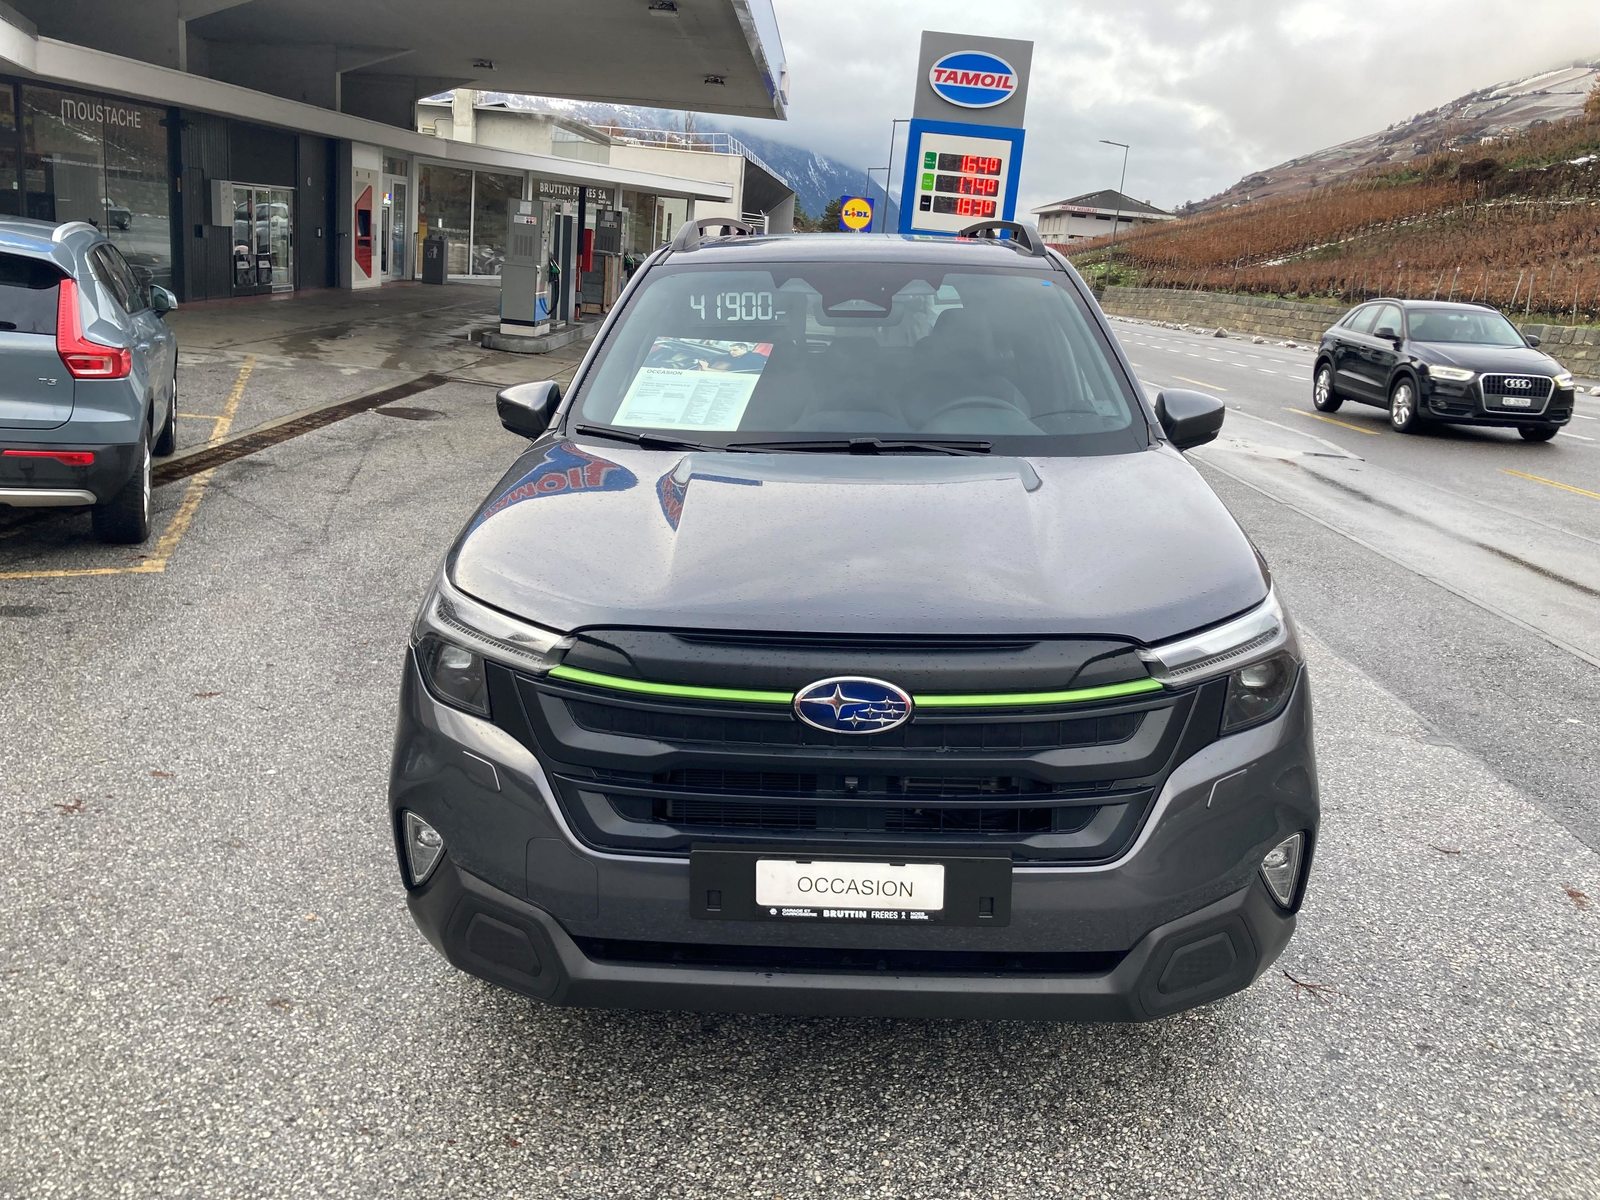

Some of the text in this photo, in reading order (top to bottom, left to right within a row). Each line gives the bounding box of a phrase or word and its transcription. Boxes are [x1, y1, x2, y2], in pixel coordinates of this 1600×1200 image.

[933, 68, 1014, 90] TAMOIL
[61, 99, 142, 129] MOUSTACHE
[539, 182, 571, 195] BRUTTIN
[598, 189, 607, 200] SA
[646, 368, 684, 377] OCCASION
[797, 876, 914, 898] OCCASION
[823, 909, 867, 919] BRUTTIN
